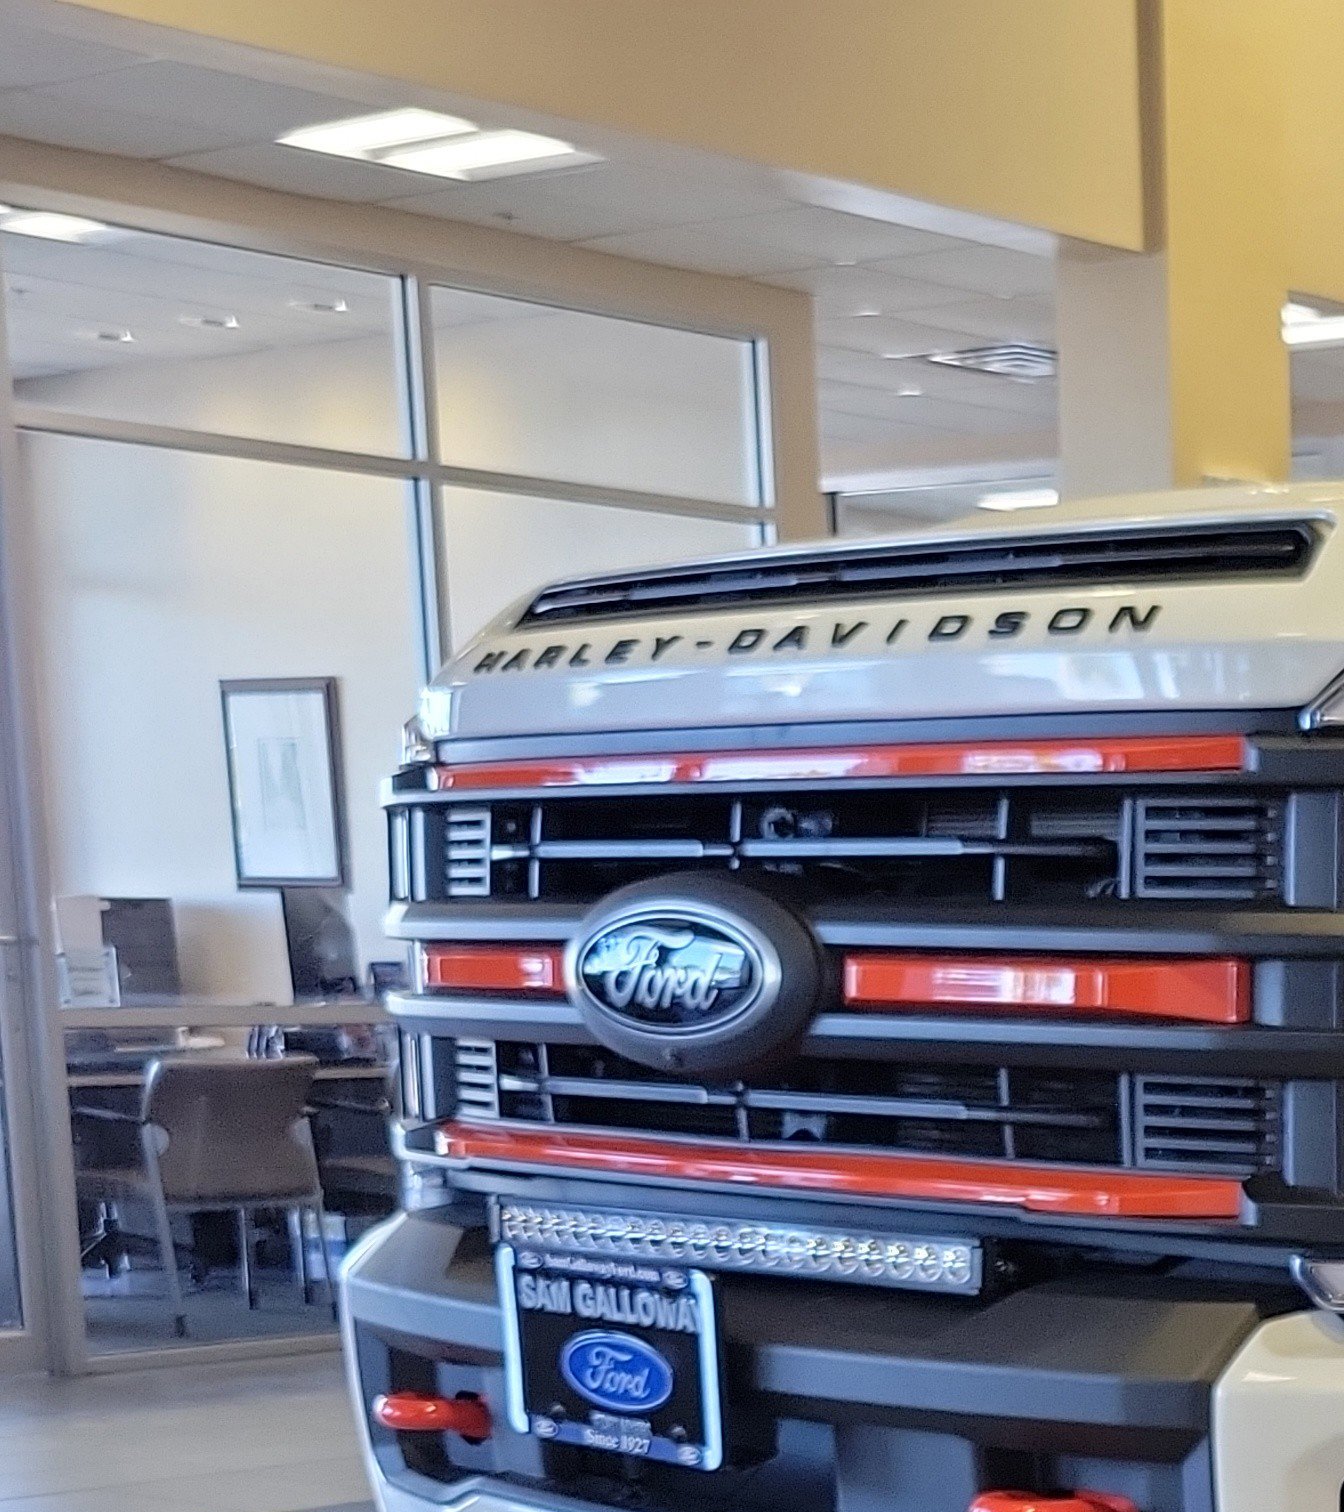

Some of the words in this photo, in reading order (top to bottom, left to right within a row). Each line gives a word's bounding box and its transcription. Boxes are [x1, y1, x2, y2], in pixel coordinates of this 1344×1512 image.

[472, 604, 1162, 676] HARLEY-DAVIDSON
[603, 924, 719, 1010] Ford
[517, 1271, 573, 1315] SAM
[584, 1346, 652, 1399] Ford
[585, 1428, 620, 1450] Since
[620, 1434, 651, 1456] 1927
